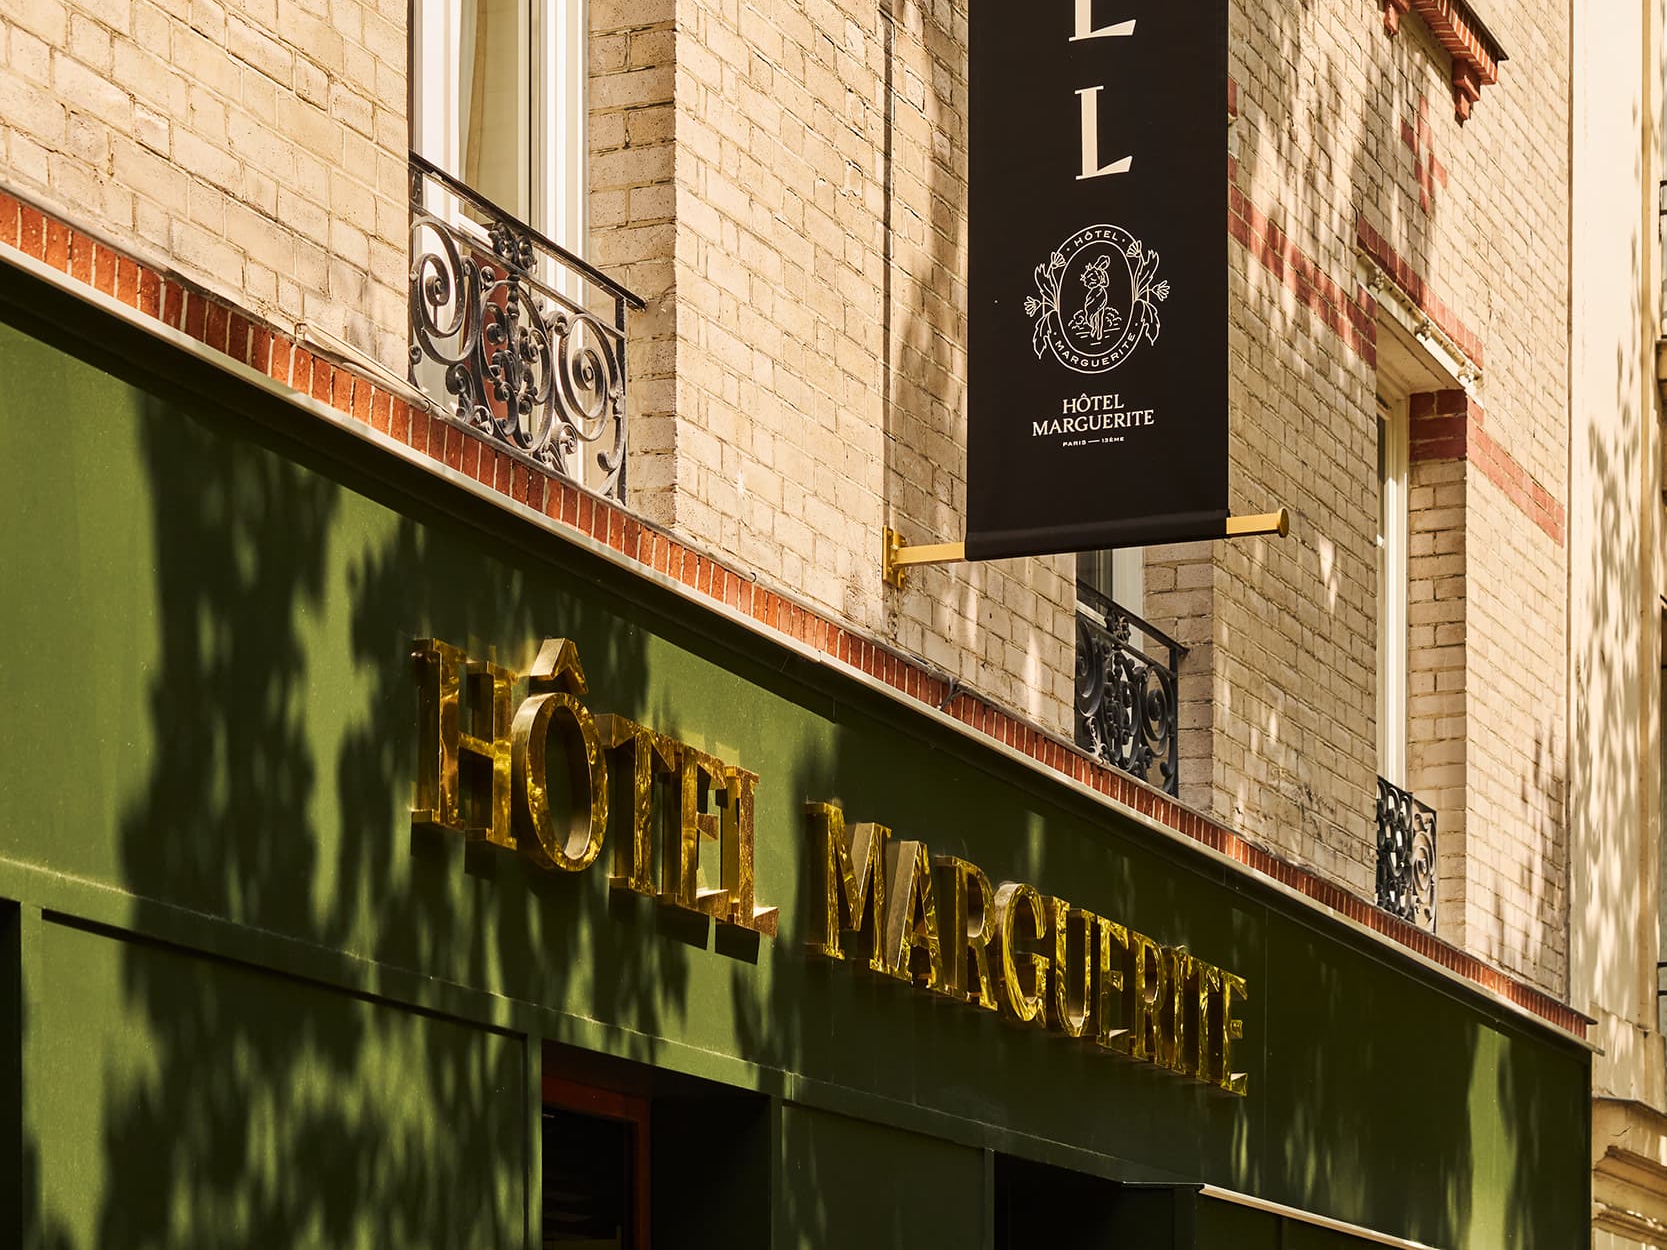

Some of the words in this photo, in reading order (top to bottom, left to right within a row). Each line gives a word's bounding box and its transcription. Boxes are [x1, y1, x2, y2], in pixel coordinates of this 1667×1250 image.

[1073, 230, 1119, 247] HÔTEL
[1054, 332, 1136, 368] MARGUERITE
[1062, 393, 1125, 414] HÔTEL
[1032, 409, 1155, 437] MARGUERITE
[1062, 439, 1087, 447] PARIS
[411, 637, 779, 937] HÔTEL
[804, 800, 1249, 1097] MARGUERITE
